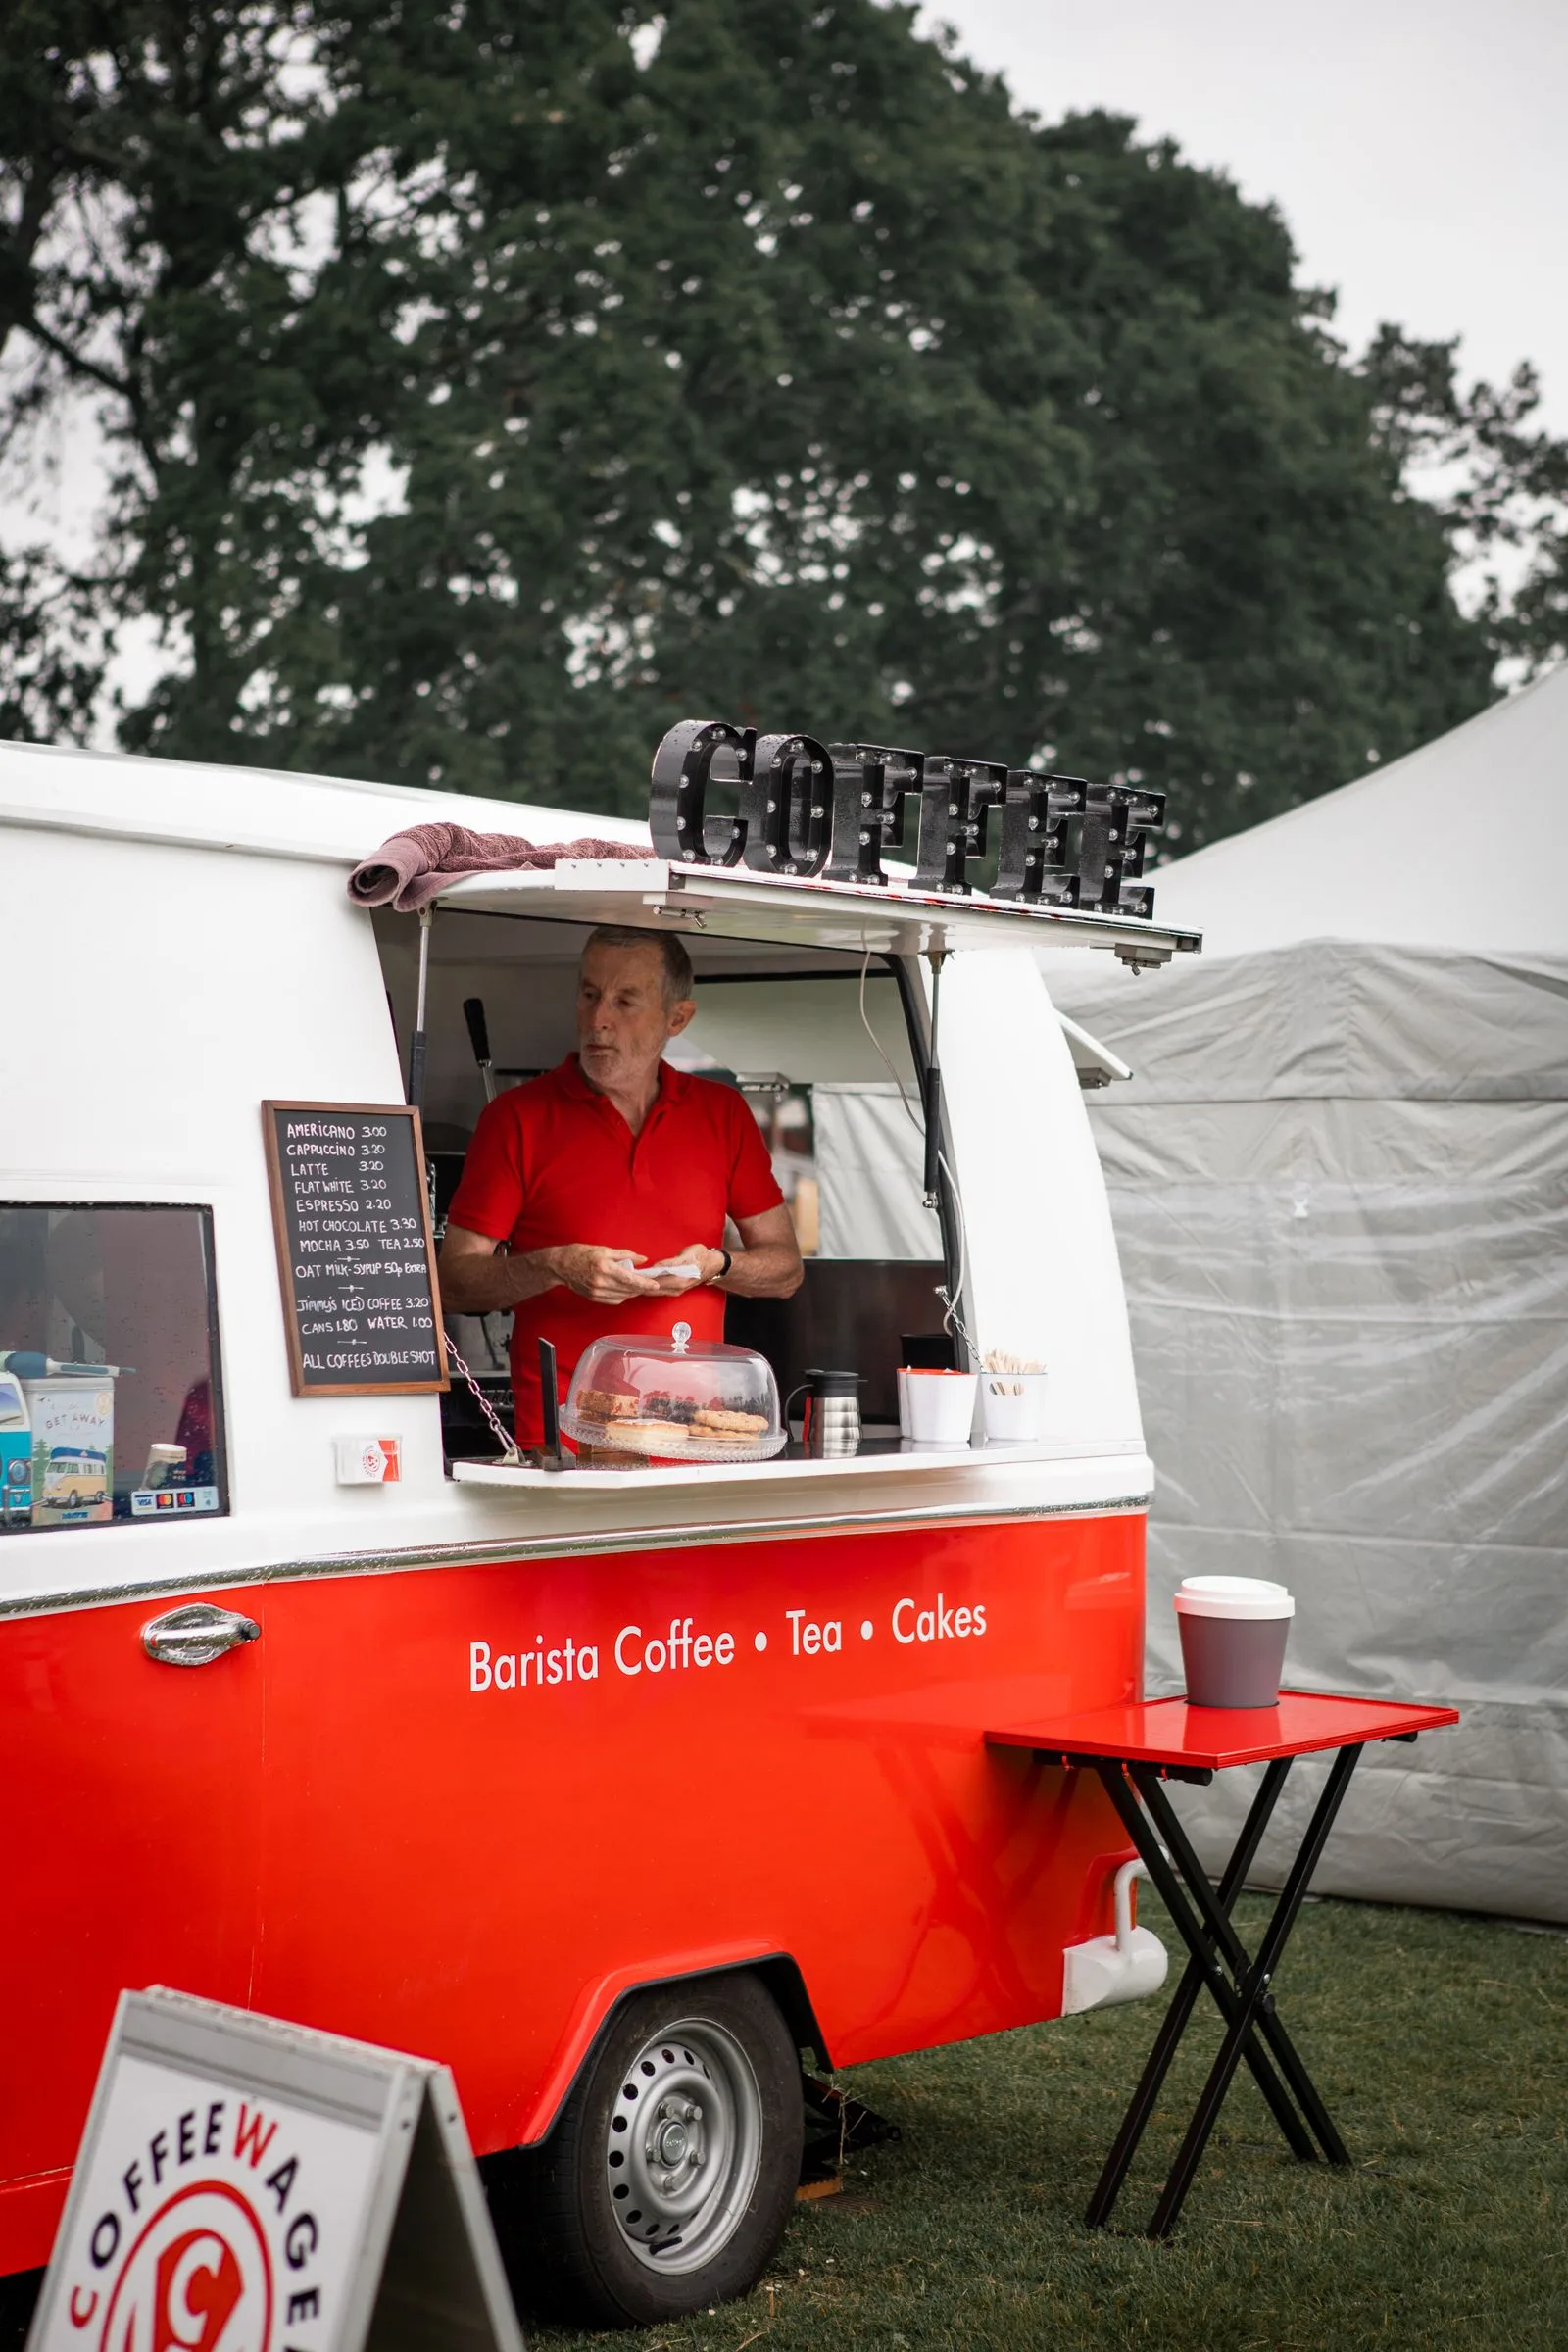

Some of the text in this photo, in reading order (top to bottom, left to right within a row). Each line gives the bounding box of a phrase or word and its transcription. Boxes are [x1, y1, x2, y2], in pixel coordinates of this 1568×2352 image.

[650, 719, 1166, 920] COFFEE
[287, 1122, 355, 1140] AMERICANO
[286, 1142, 385, 1156] CAPPUCCINO 3.20
[290, 1161, 384, 1177] LATTE 3.20
[294, 1177, 387, 1194] FLAT WHITE 3.20
[296, 1200, 391, 1213] ESPRESSO 2.20
[298, 1218, 417, 1234] HOT CHOCOLATE 3.30
[300, 1238, 425, 1253] MOCHA 3.50 TEA 2.50
[295, 1264, 321, 1278] OAT
[384, 1261, 403, 1278] 50p
[404, 1262, 427, 1274] EXTRA
[368, 1297, 403, 1311] COFFEE
[405, 1297, 429, 1308] 3.20
[302, 1323, 334, 1335] CANS
[368, 1316, 408, 1330] WATER
[303, 1350, 436, 1370] ALL COFFEES DOUBLE SHOT
[469, 1592, 988, 1691] Barista Coffee Tea Cakes
[70, 2102, 320, 2352] COFFEEWAGE
